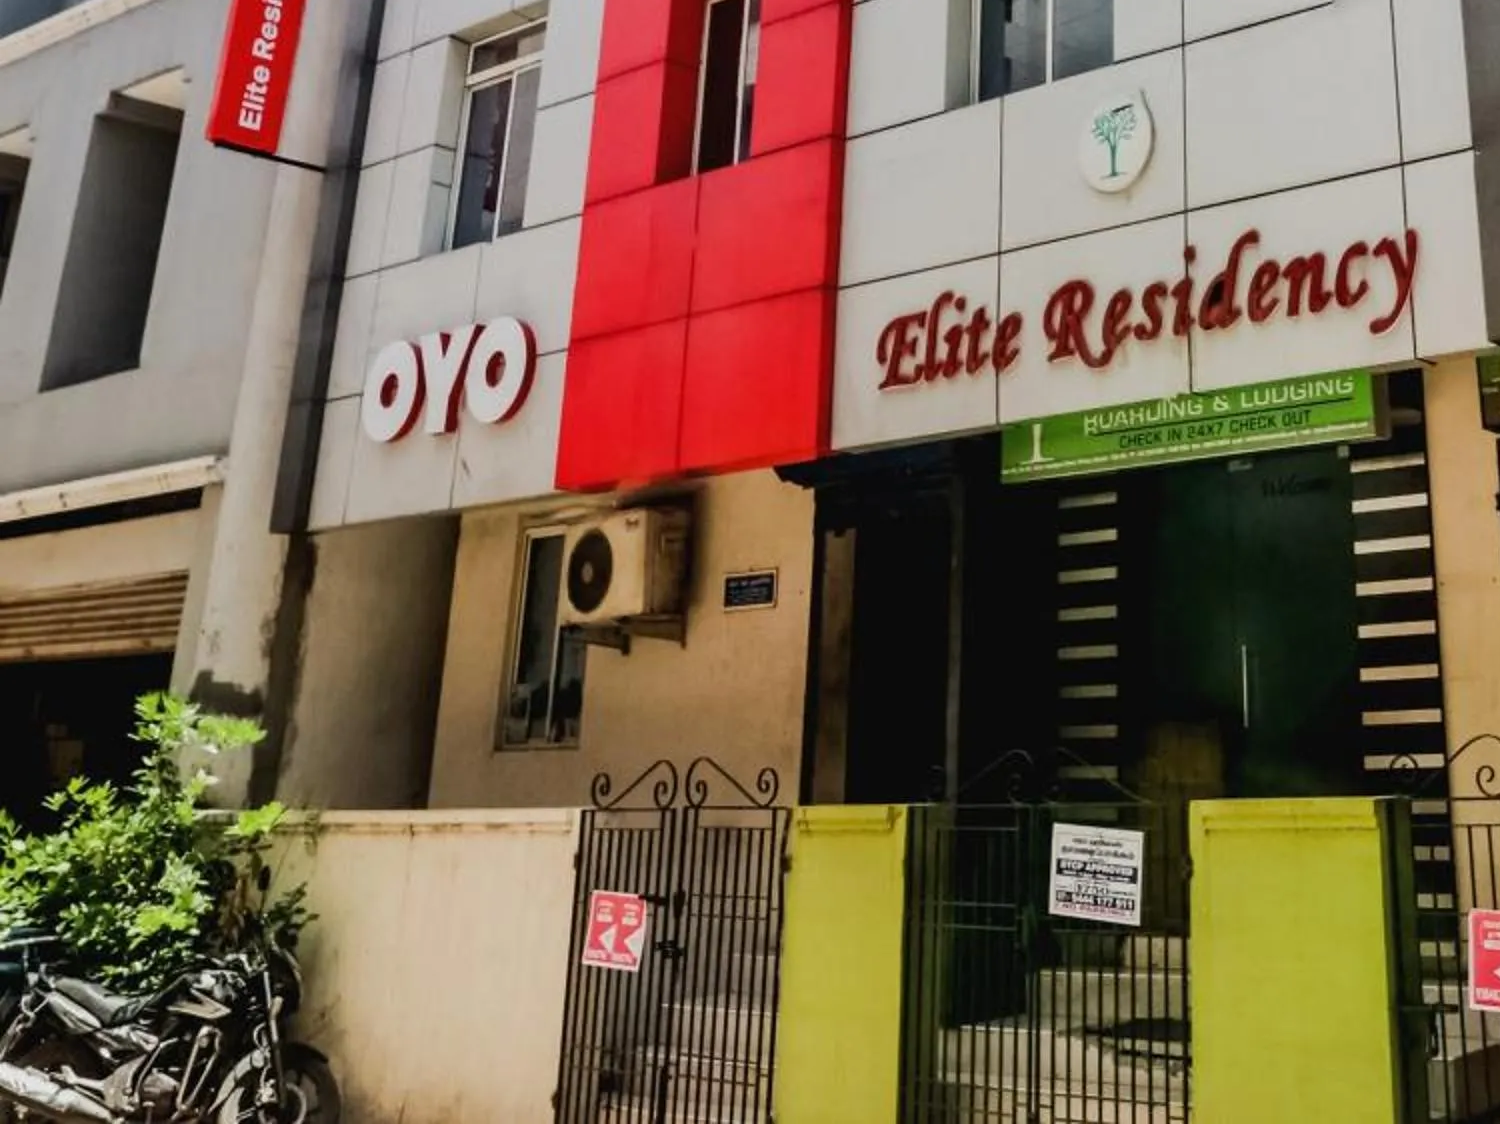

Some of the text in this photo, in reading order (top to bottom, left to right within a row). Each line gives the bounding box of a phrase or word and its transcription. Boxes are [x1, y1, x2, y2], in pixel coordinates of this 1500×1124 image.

[238, 64, 271, 132] Elite
[877, 227, 1420, 390] Elite Residency
[362, 315, 537, 443] OYO
[1119, 430, 1162, 449] CHECK
[1167, 428, 1182, 442] IN
[1187, 421, 1224, 439] 24X7
[1229, 416, 1275, 434] CHECK
[1281, 409, 1313, 426] OUT
